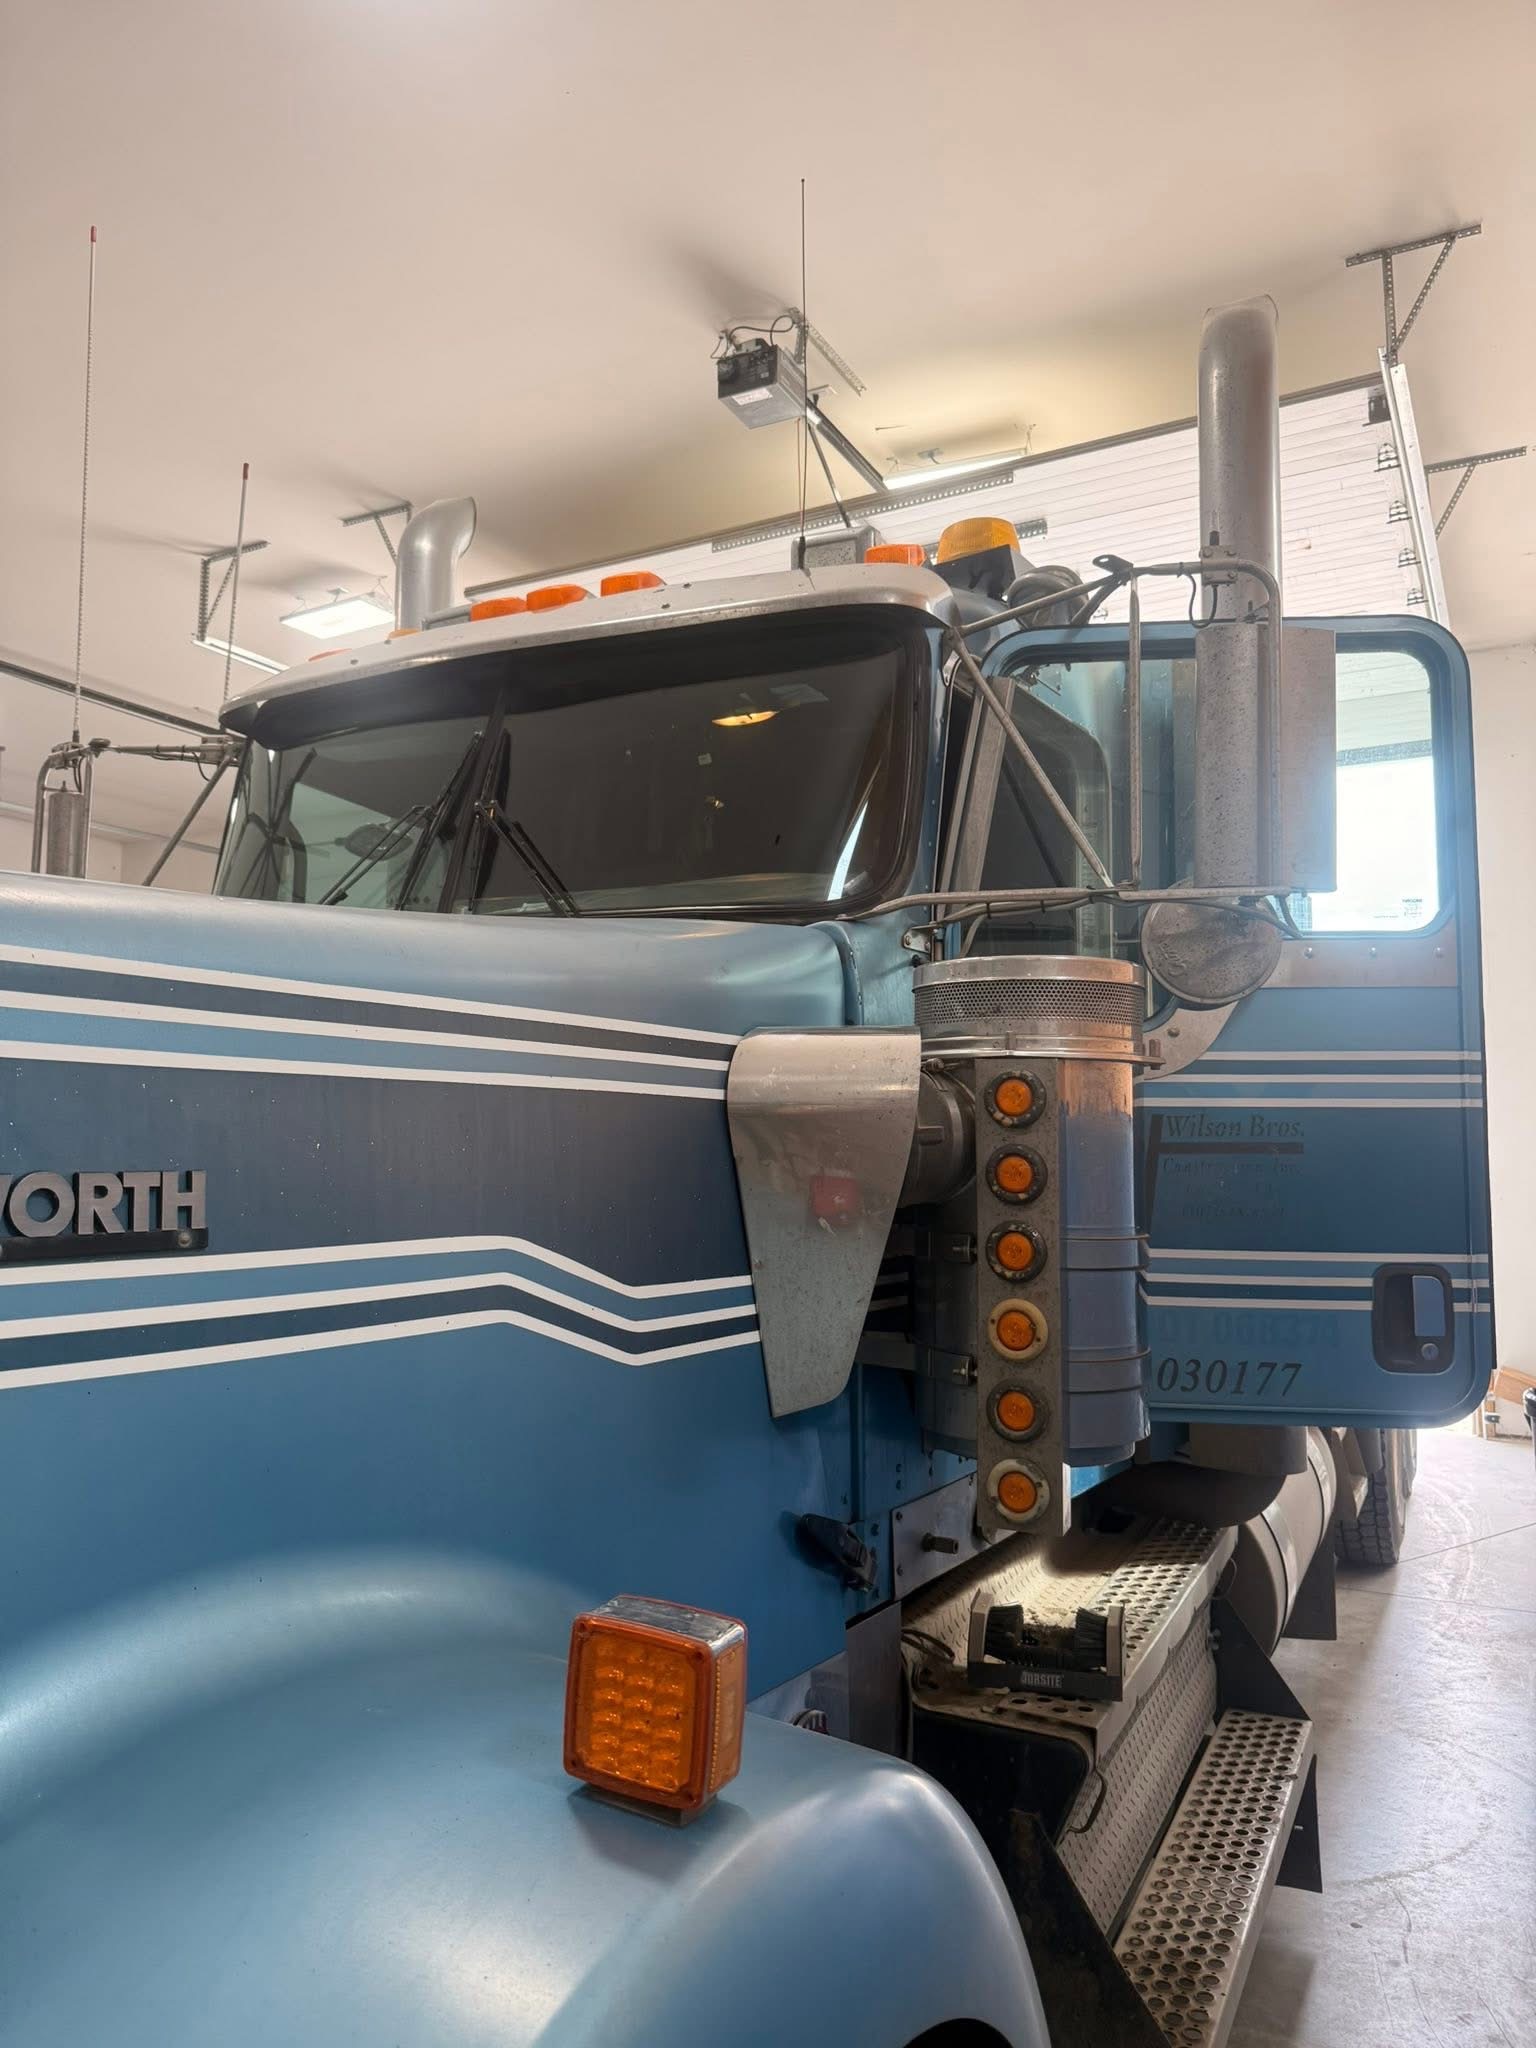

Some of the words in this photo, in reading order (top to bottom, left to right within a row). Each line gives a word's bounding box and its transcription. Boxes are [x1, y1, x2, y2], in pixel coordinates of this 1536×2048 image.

[1166, 1113, 1242, 1137] Wilson
[1250, 1114, 1305, 1137] Bros.
[0, 1170, 206, 1238] ORTH
[1156, 1357, 1303, 1396] 030177
